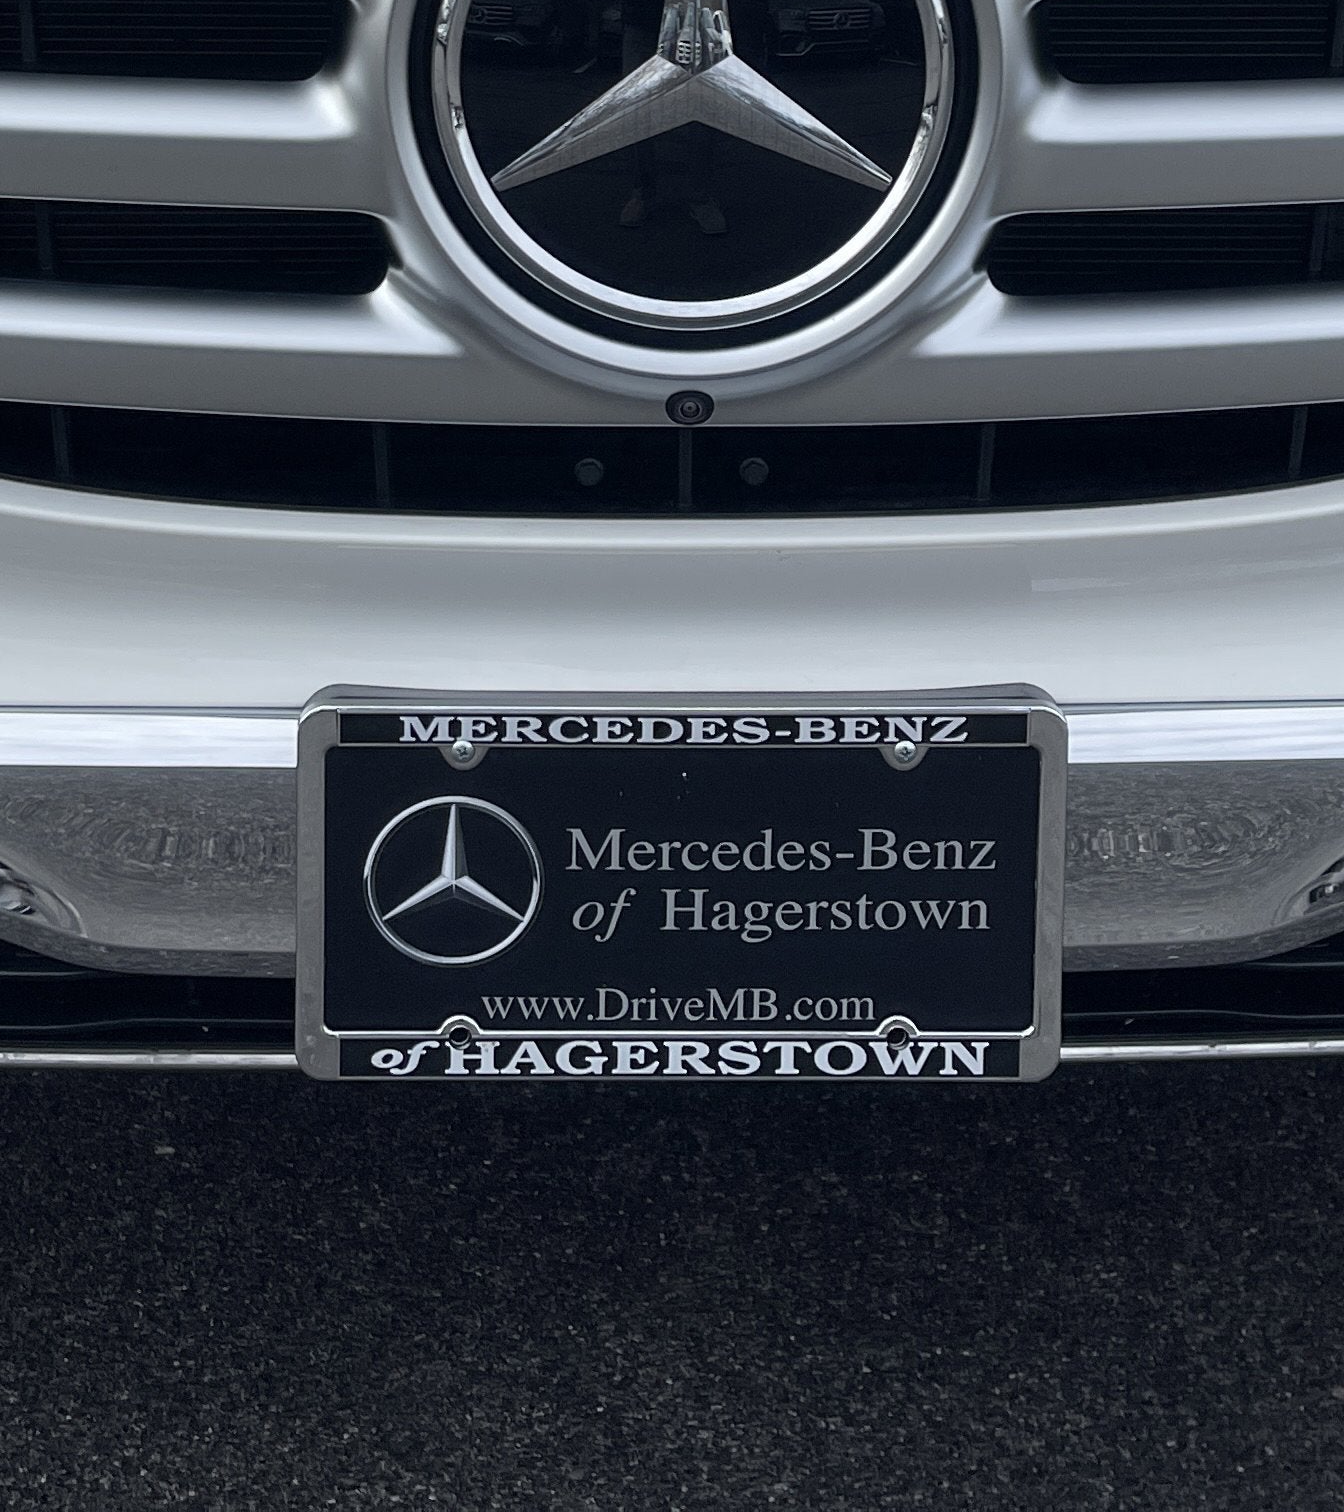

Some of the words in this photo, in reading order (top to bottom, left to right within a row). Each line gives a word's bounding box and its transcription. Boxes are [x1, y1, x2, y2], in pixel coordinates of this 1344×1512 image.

[399, 715, 969, 744] MERCEDES-BENZ
[565, 827, 997, 872] Mercedes-Benz
[572, 887, 637, 943] of
[659, 888, 991, 943] Hagerstown
[481, 987, 876, 1023] www.DriveMB.com
[371, 1041, 438, 1075] of
[444, 1040, 990, 1076] HAGERSTOWN
